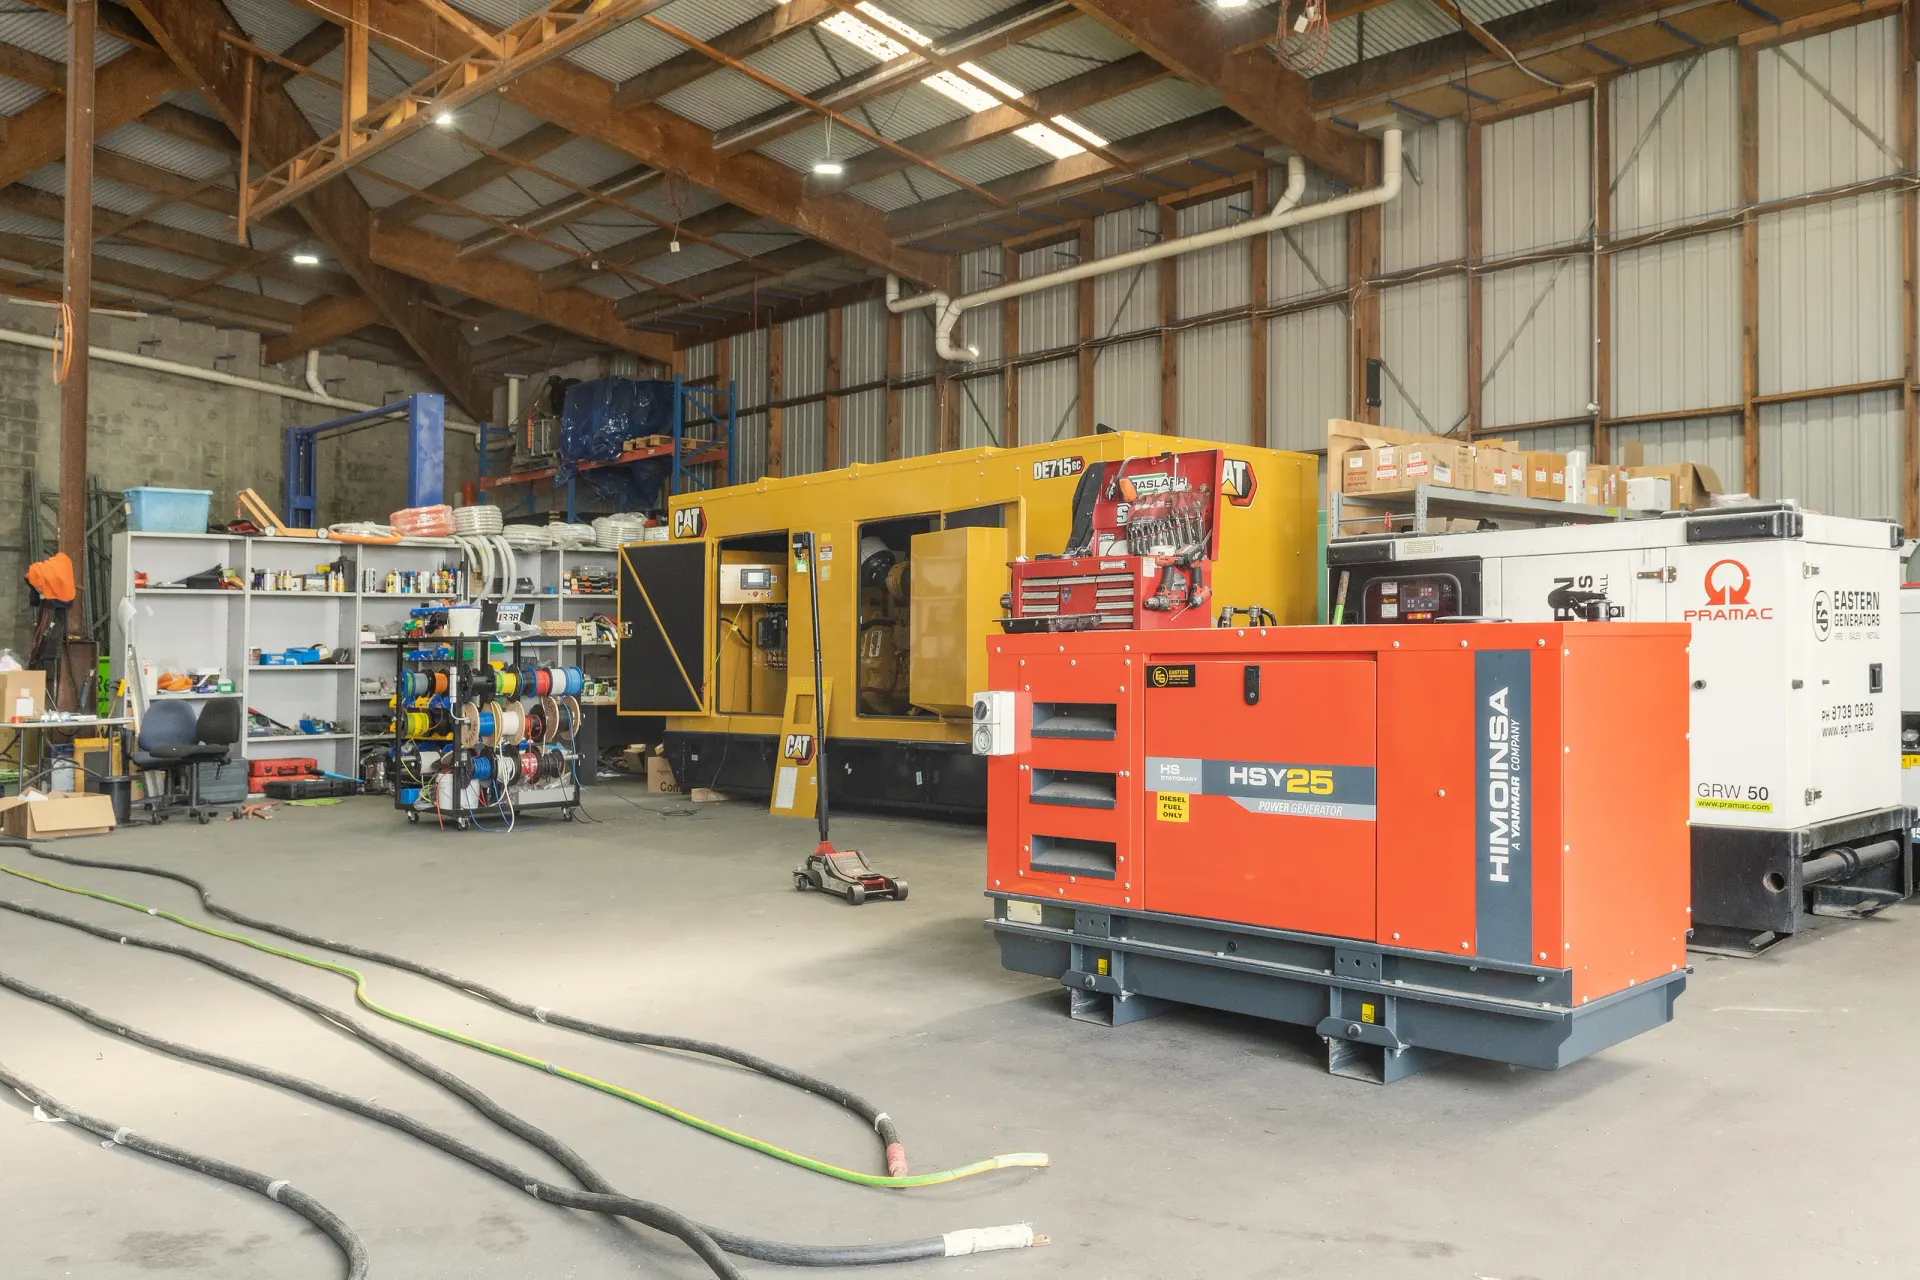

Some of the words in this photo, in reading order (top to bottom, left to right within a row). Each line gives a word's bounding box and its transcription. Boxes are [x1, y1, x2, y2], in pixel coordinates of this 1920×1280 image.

[1220, 459, 1246, 496] AT
[674, 507, 700, 538] CAT
[1834, 590, 1880, 611] EASTERN
[1684, 608, 1773, 621] PRAMAC
[1834, 613, 1881, 627] GENERATORS
[1821, 710, 1831, 721] PH
[1832, 704, 1852, 720] 9739
[1854, 702, 1874, 718] 0938
[1822, 721, 1875, 738] www.egh.net.au
[785, 734, 811, 758] CAT
[1511, 719, 1520, 771] COMPANY
[1160, 764, 1180, 775] HS
[1160, 775, 1198, 783] STATIONARY
[1229, 766, 1334, 795] HSY25
[1489, 686, 1509, 883] HIMOINSA
[1159, 795, 1187, 803] DIESEL
[1697, 782, 1742, 799] GRW
[1747, 786, 1769, 801] 50
[1163, 803, 1183, 811] FUEL
[1258, 801, 1289, 813] POWER
[1291, 803, 1343, 817] GENERATOR
[1511, 775, 1520, 839] YANMAR
[1697, 800, 1770, 811] www.pramac.com
[1511, 842, 1520, 851] A
